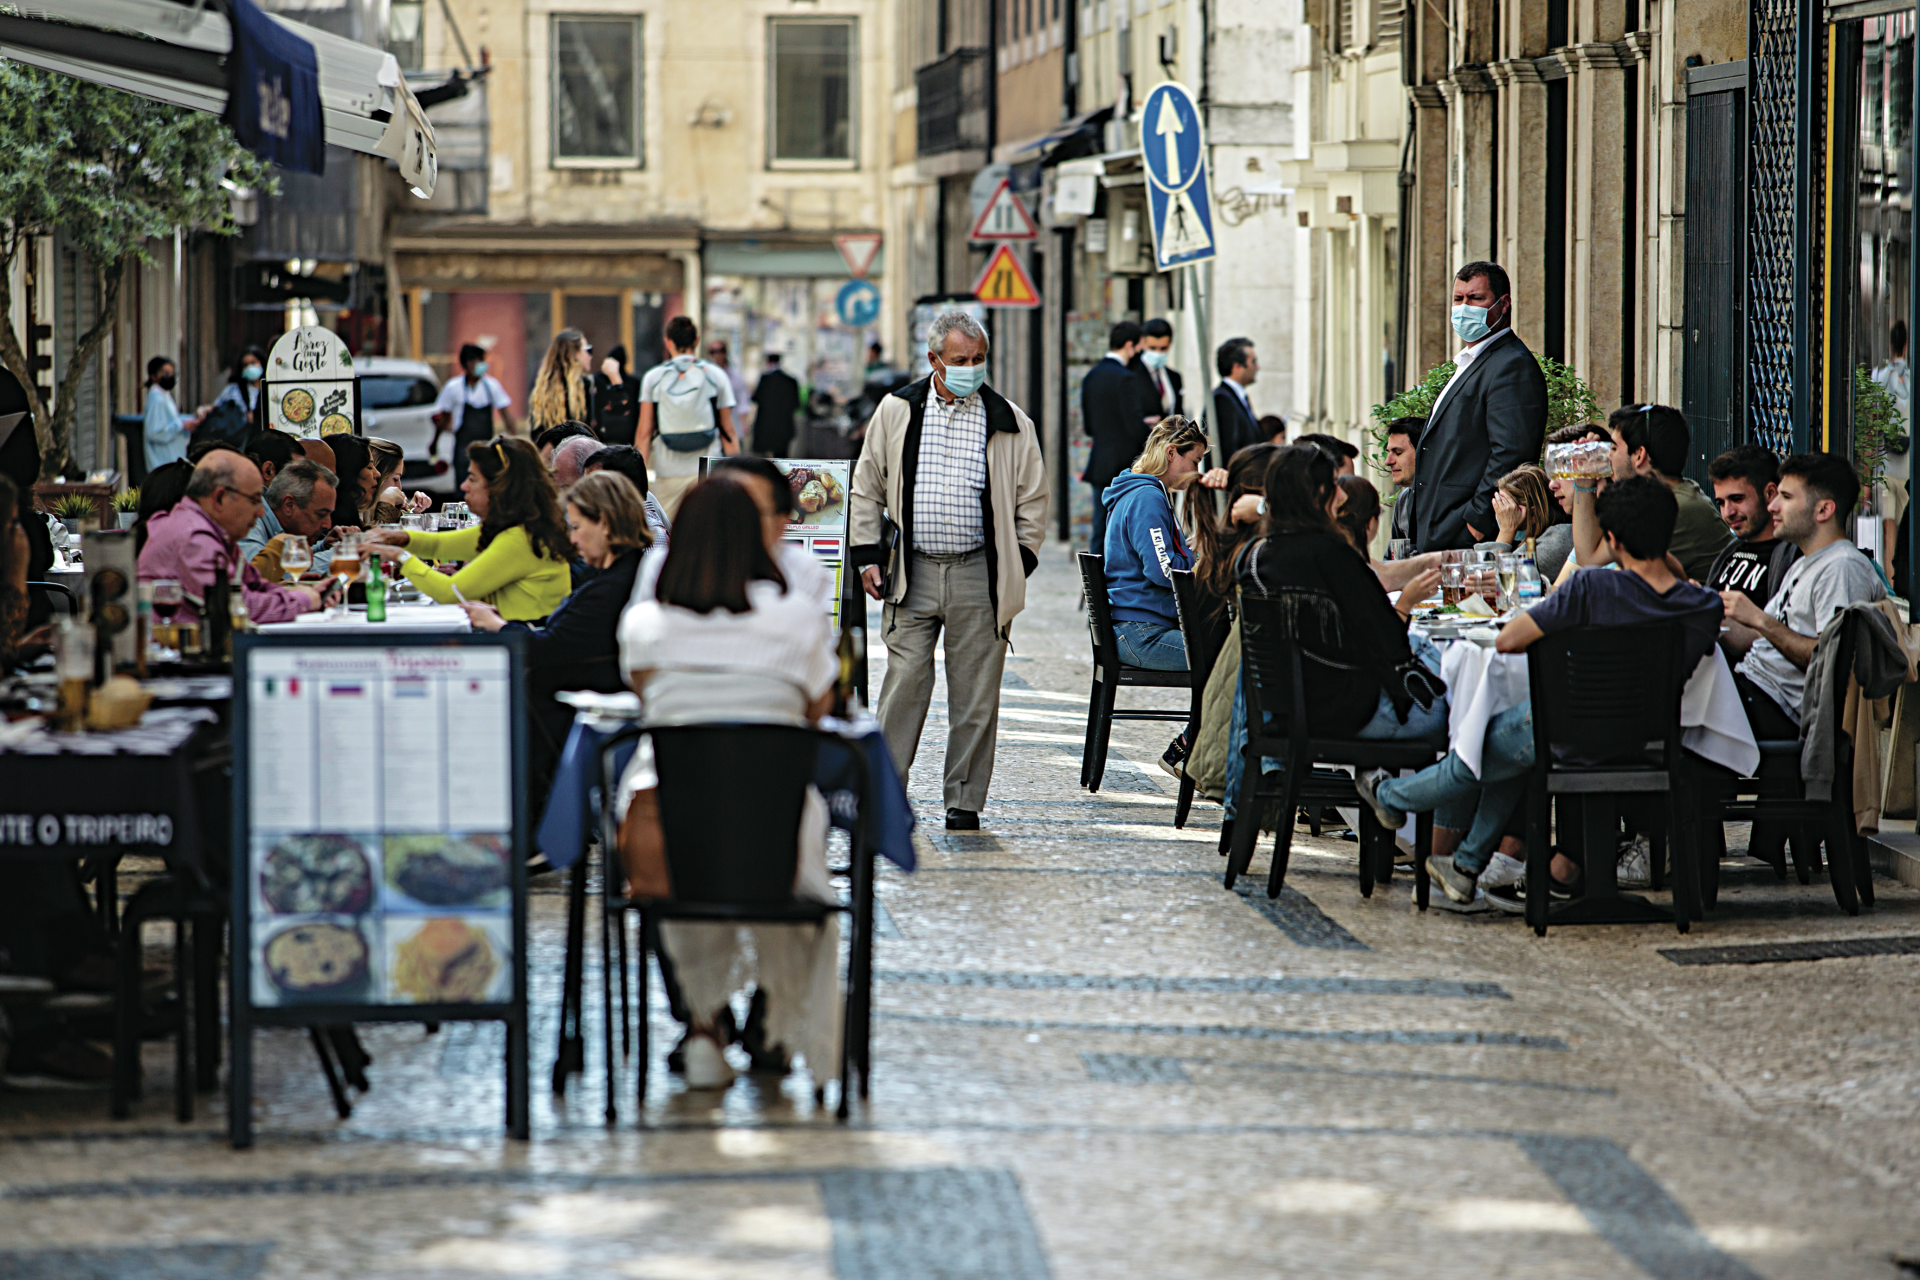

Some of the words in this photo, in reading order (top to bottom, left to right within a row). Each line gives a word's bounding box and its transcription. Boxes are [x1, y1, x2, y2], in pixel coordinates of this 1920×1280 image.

[293, 352, 327, 373] Gosto
[38, 814, 60, 845] O
[65, 814, 173, 845] TRIPEIRO
